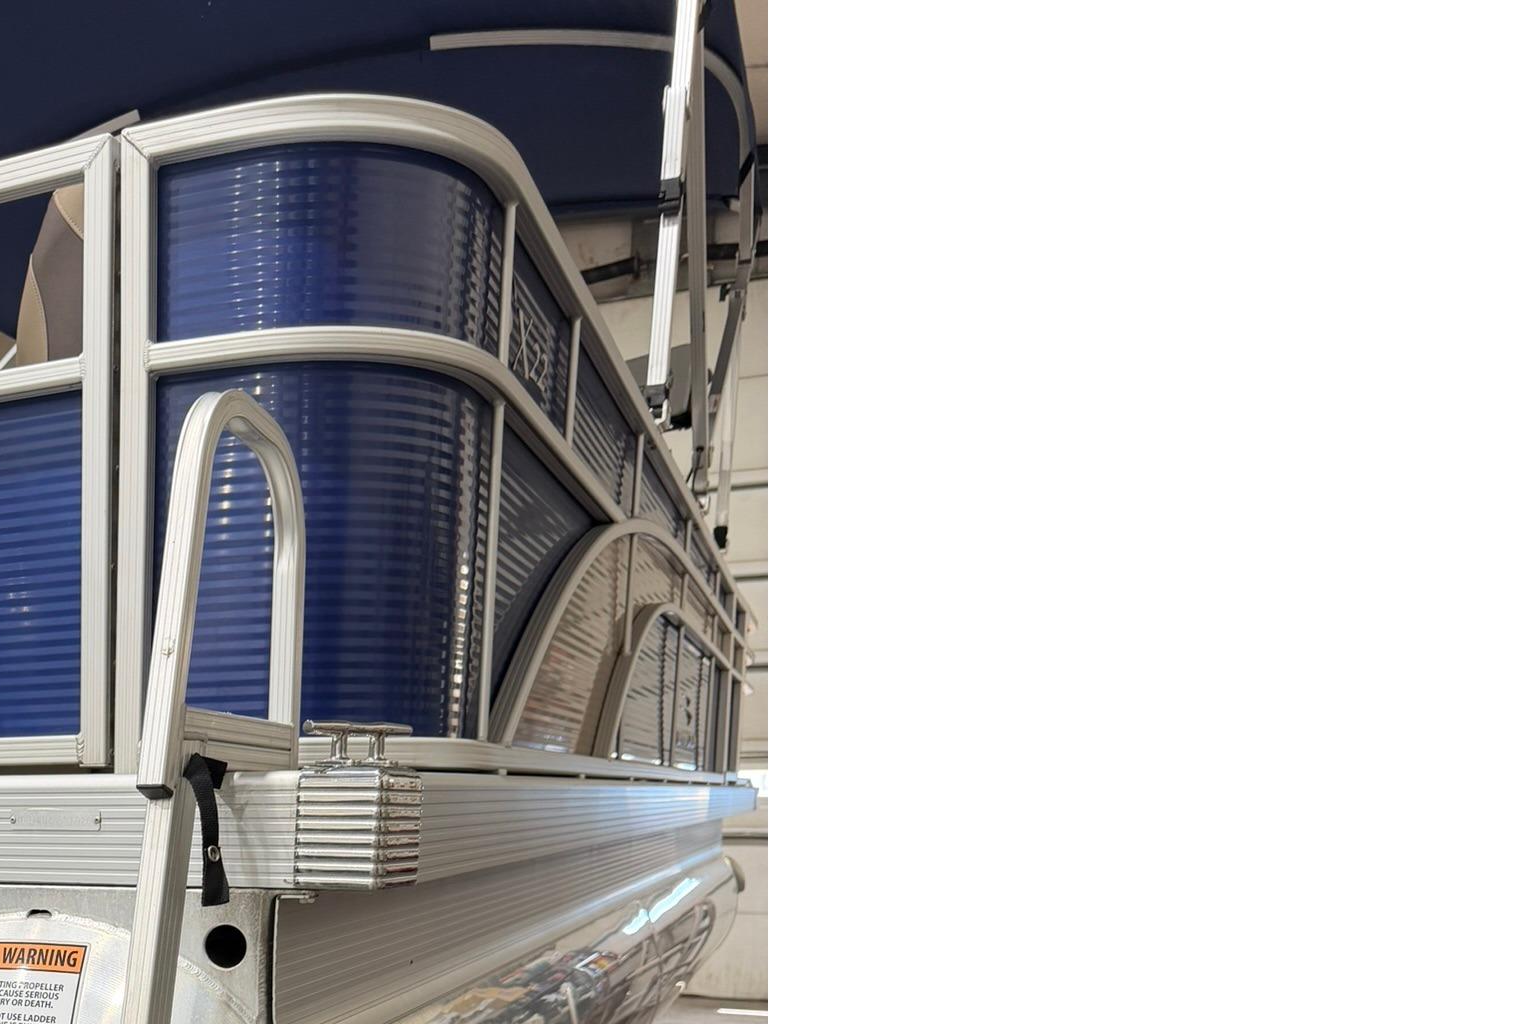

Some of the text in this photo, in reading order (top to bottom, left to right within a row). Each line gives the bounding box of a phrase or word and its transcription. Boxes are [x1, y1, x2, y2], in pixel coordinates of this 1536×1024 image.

[2, 947, 79, 968] WARNING
[25, 990, 60, 1000] SERIOUS
[11, 998, 23, 1006] OR
[24, 999, 54, 1009] DEATH.
[6, 1012, 22, 1021] USE
[23, 1014, 57, 1024] LADDER
